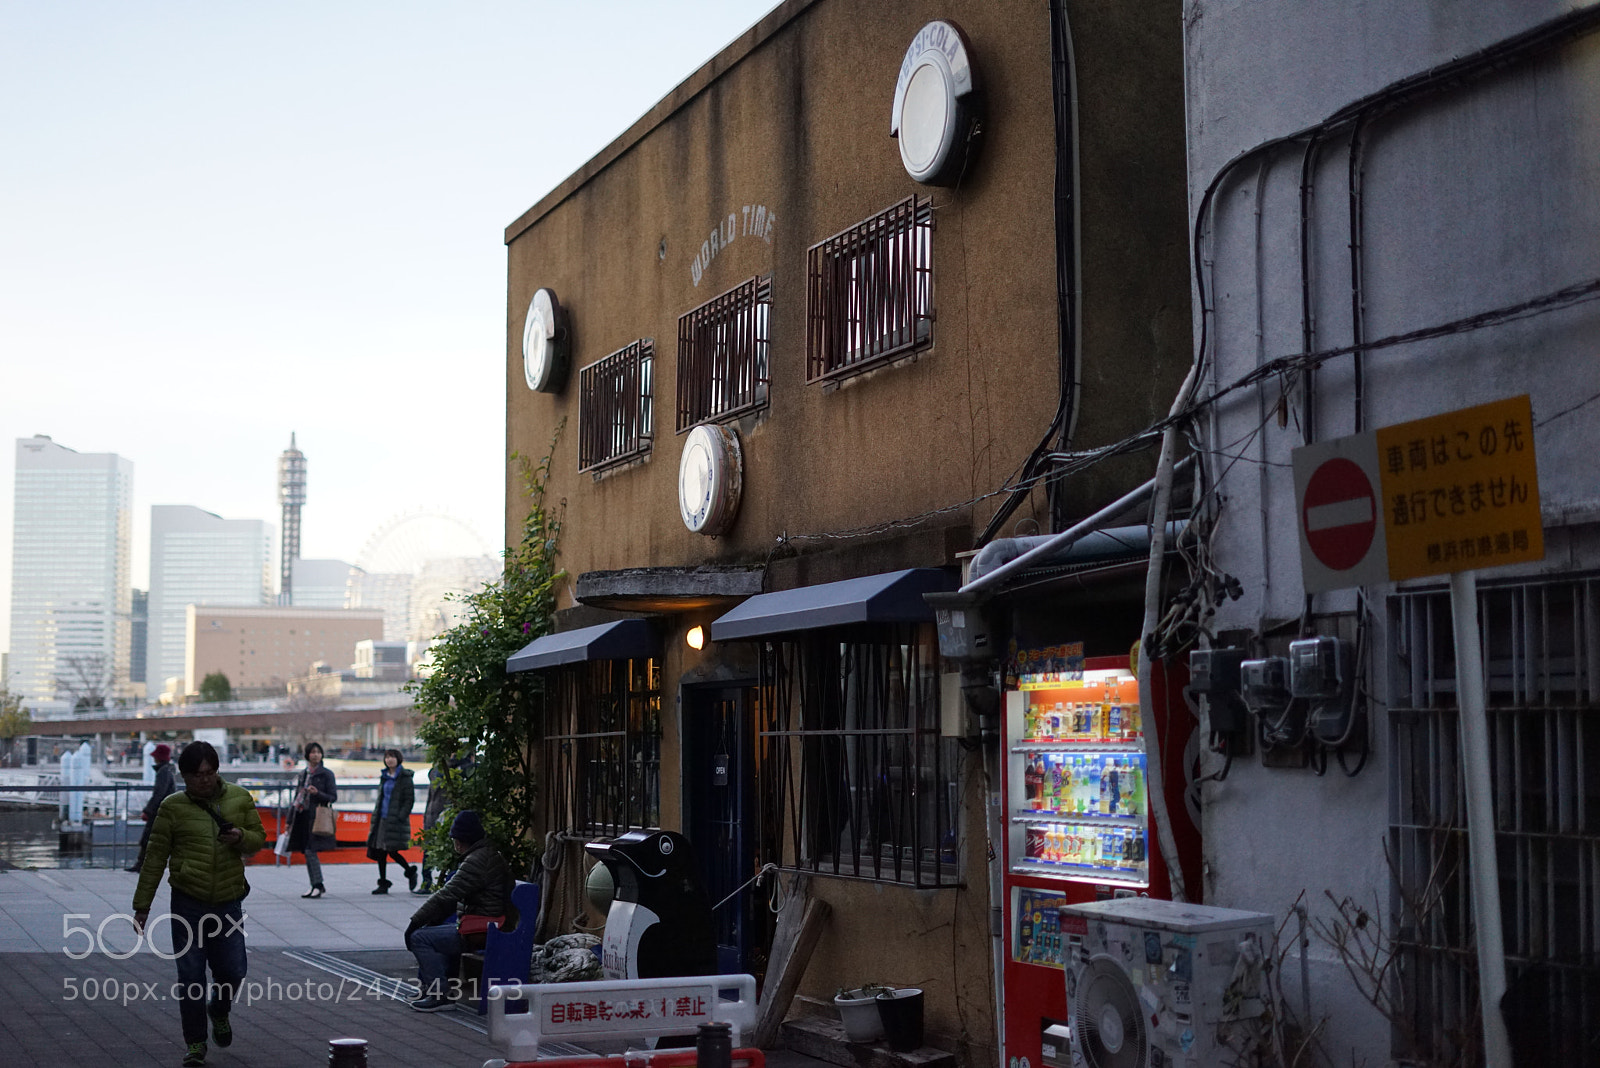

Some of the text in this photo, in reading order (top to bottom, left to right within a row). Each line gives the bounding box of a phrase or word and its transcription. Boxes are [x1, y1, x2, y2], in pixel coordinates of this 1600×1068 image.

[690, 205, 776, 287] WORLD TIME
[1386, 419, 1524, 477] 車両はこの先
[1392, 474, 1528, 526] 通行できません
[715, 766, 726, 775] OPEN
